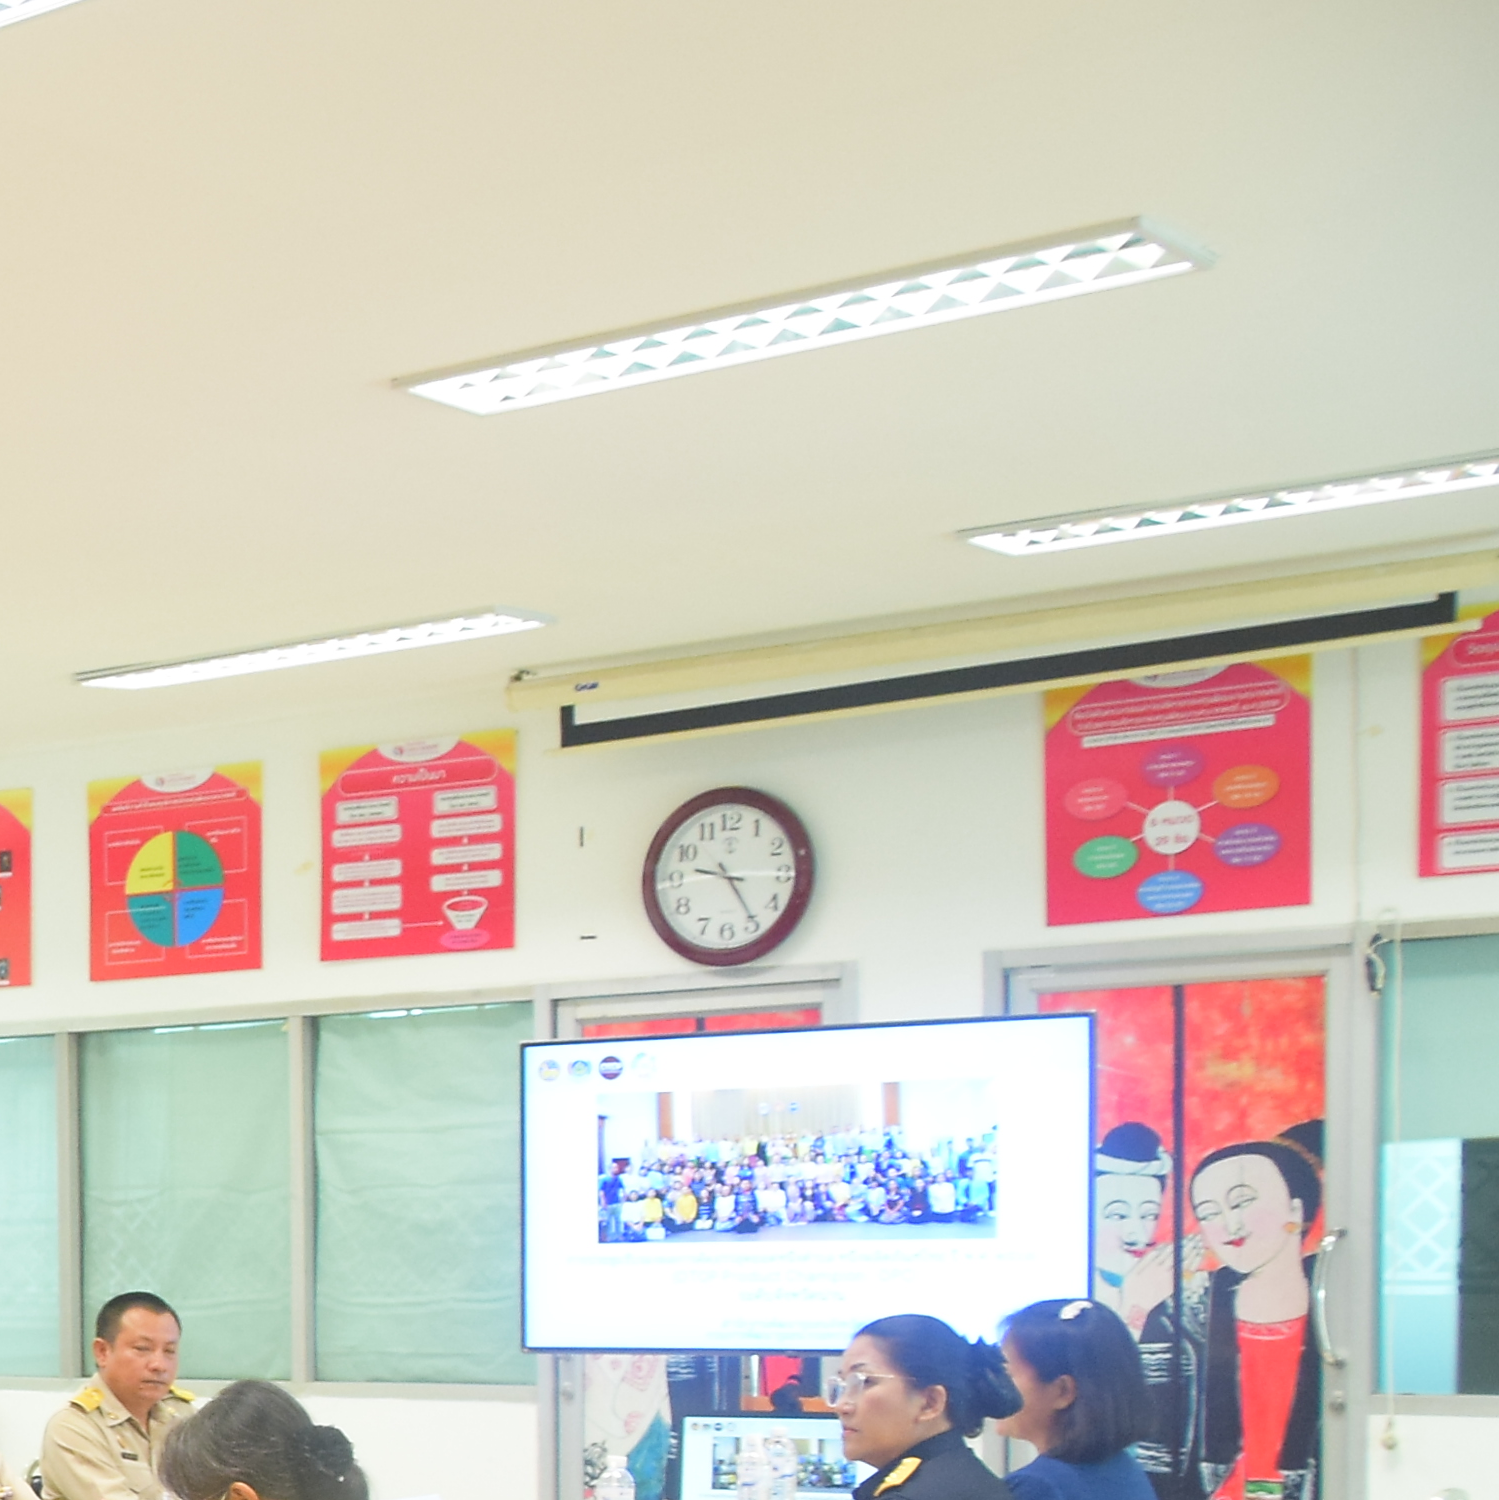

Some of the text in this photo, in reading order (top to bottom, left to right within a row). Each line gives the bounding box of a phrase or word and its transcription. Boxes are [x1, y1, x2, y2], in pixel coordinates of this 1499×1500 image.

[698, 822, 716, 841] 11
[720, 812, 743, 832] 12
[753, 818, 761, 838] 1
[678, 843, 698, 863] 10
[769, 836, 785, 857] 2
[668, 869, 684, 889] 9
[775, 864, 792, 884] 3
[675, 896, 691, 916] 8
[764, 892, 780, 912] 4
[696, 917, 712, 936] 7
[719, 921, 735, 941] 6
[744, 914, 760, 934] 5
